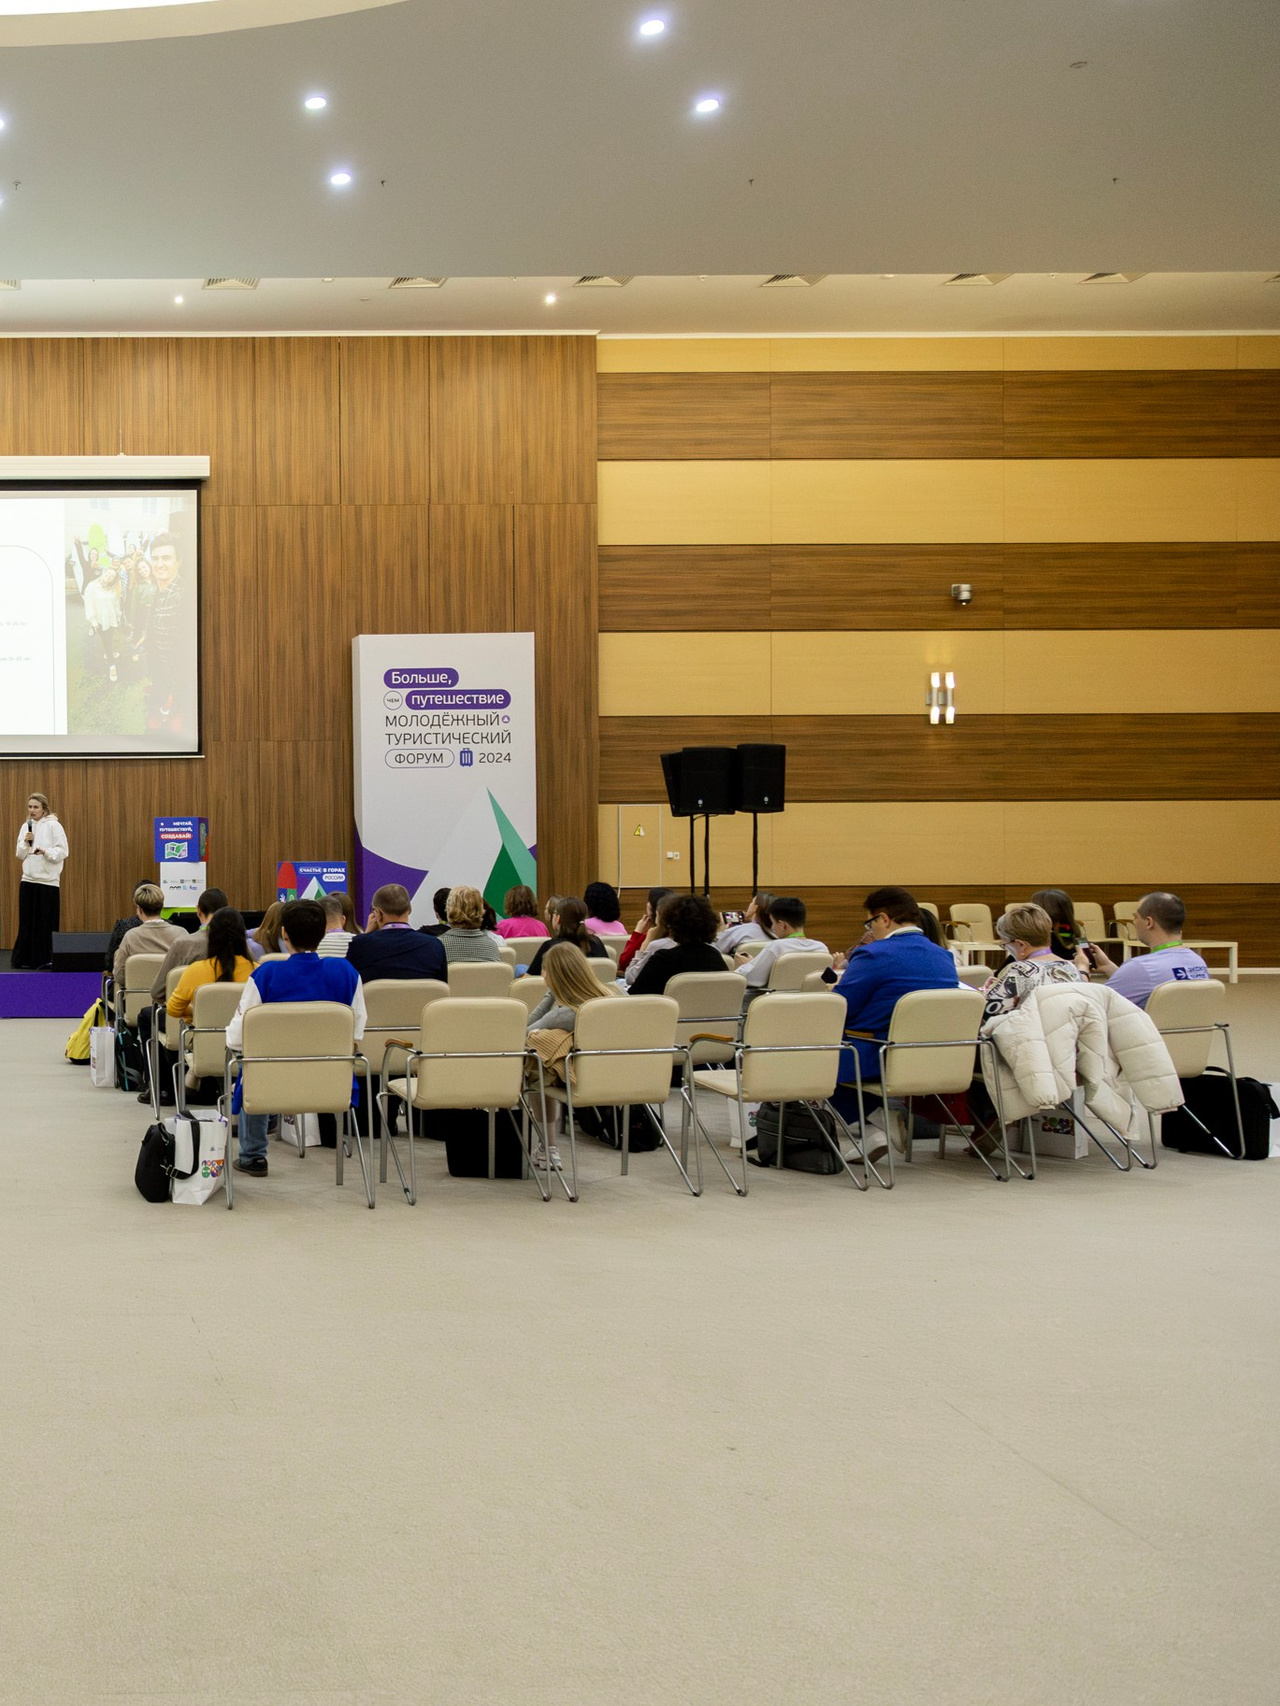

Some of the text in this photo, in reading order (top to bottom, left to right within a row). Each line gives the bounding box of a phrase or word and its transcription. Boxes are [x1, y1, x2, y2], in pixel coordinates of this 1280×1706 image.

[392, 672, 452, 685] Больше,
[411, 693, 505, 707] путешествие
[385, 711, 500, 729] МОЛОДЁЖНЫЙ
[385, 730, 512, 746] ТУРИСТИЧЕСКИЙ
[394, 752, 512, 765] ФОРУМ 2024
